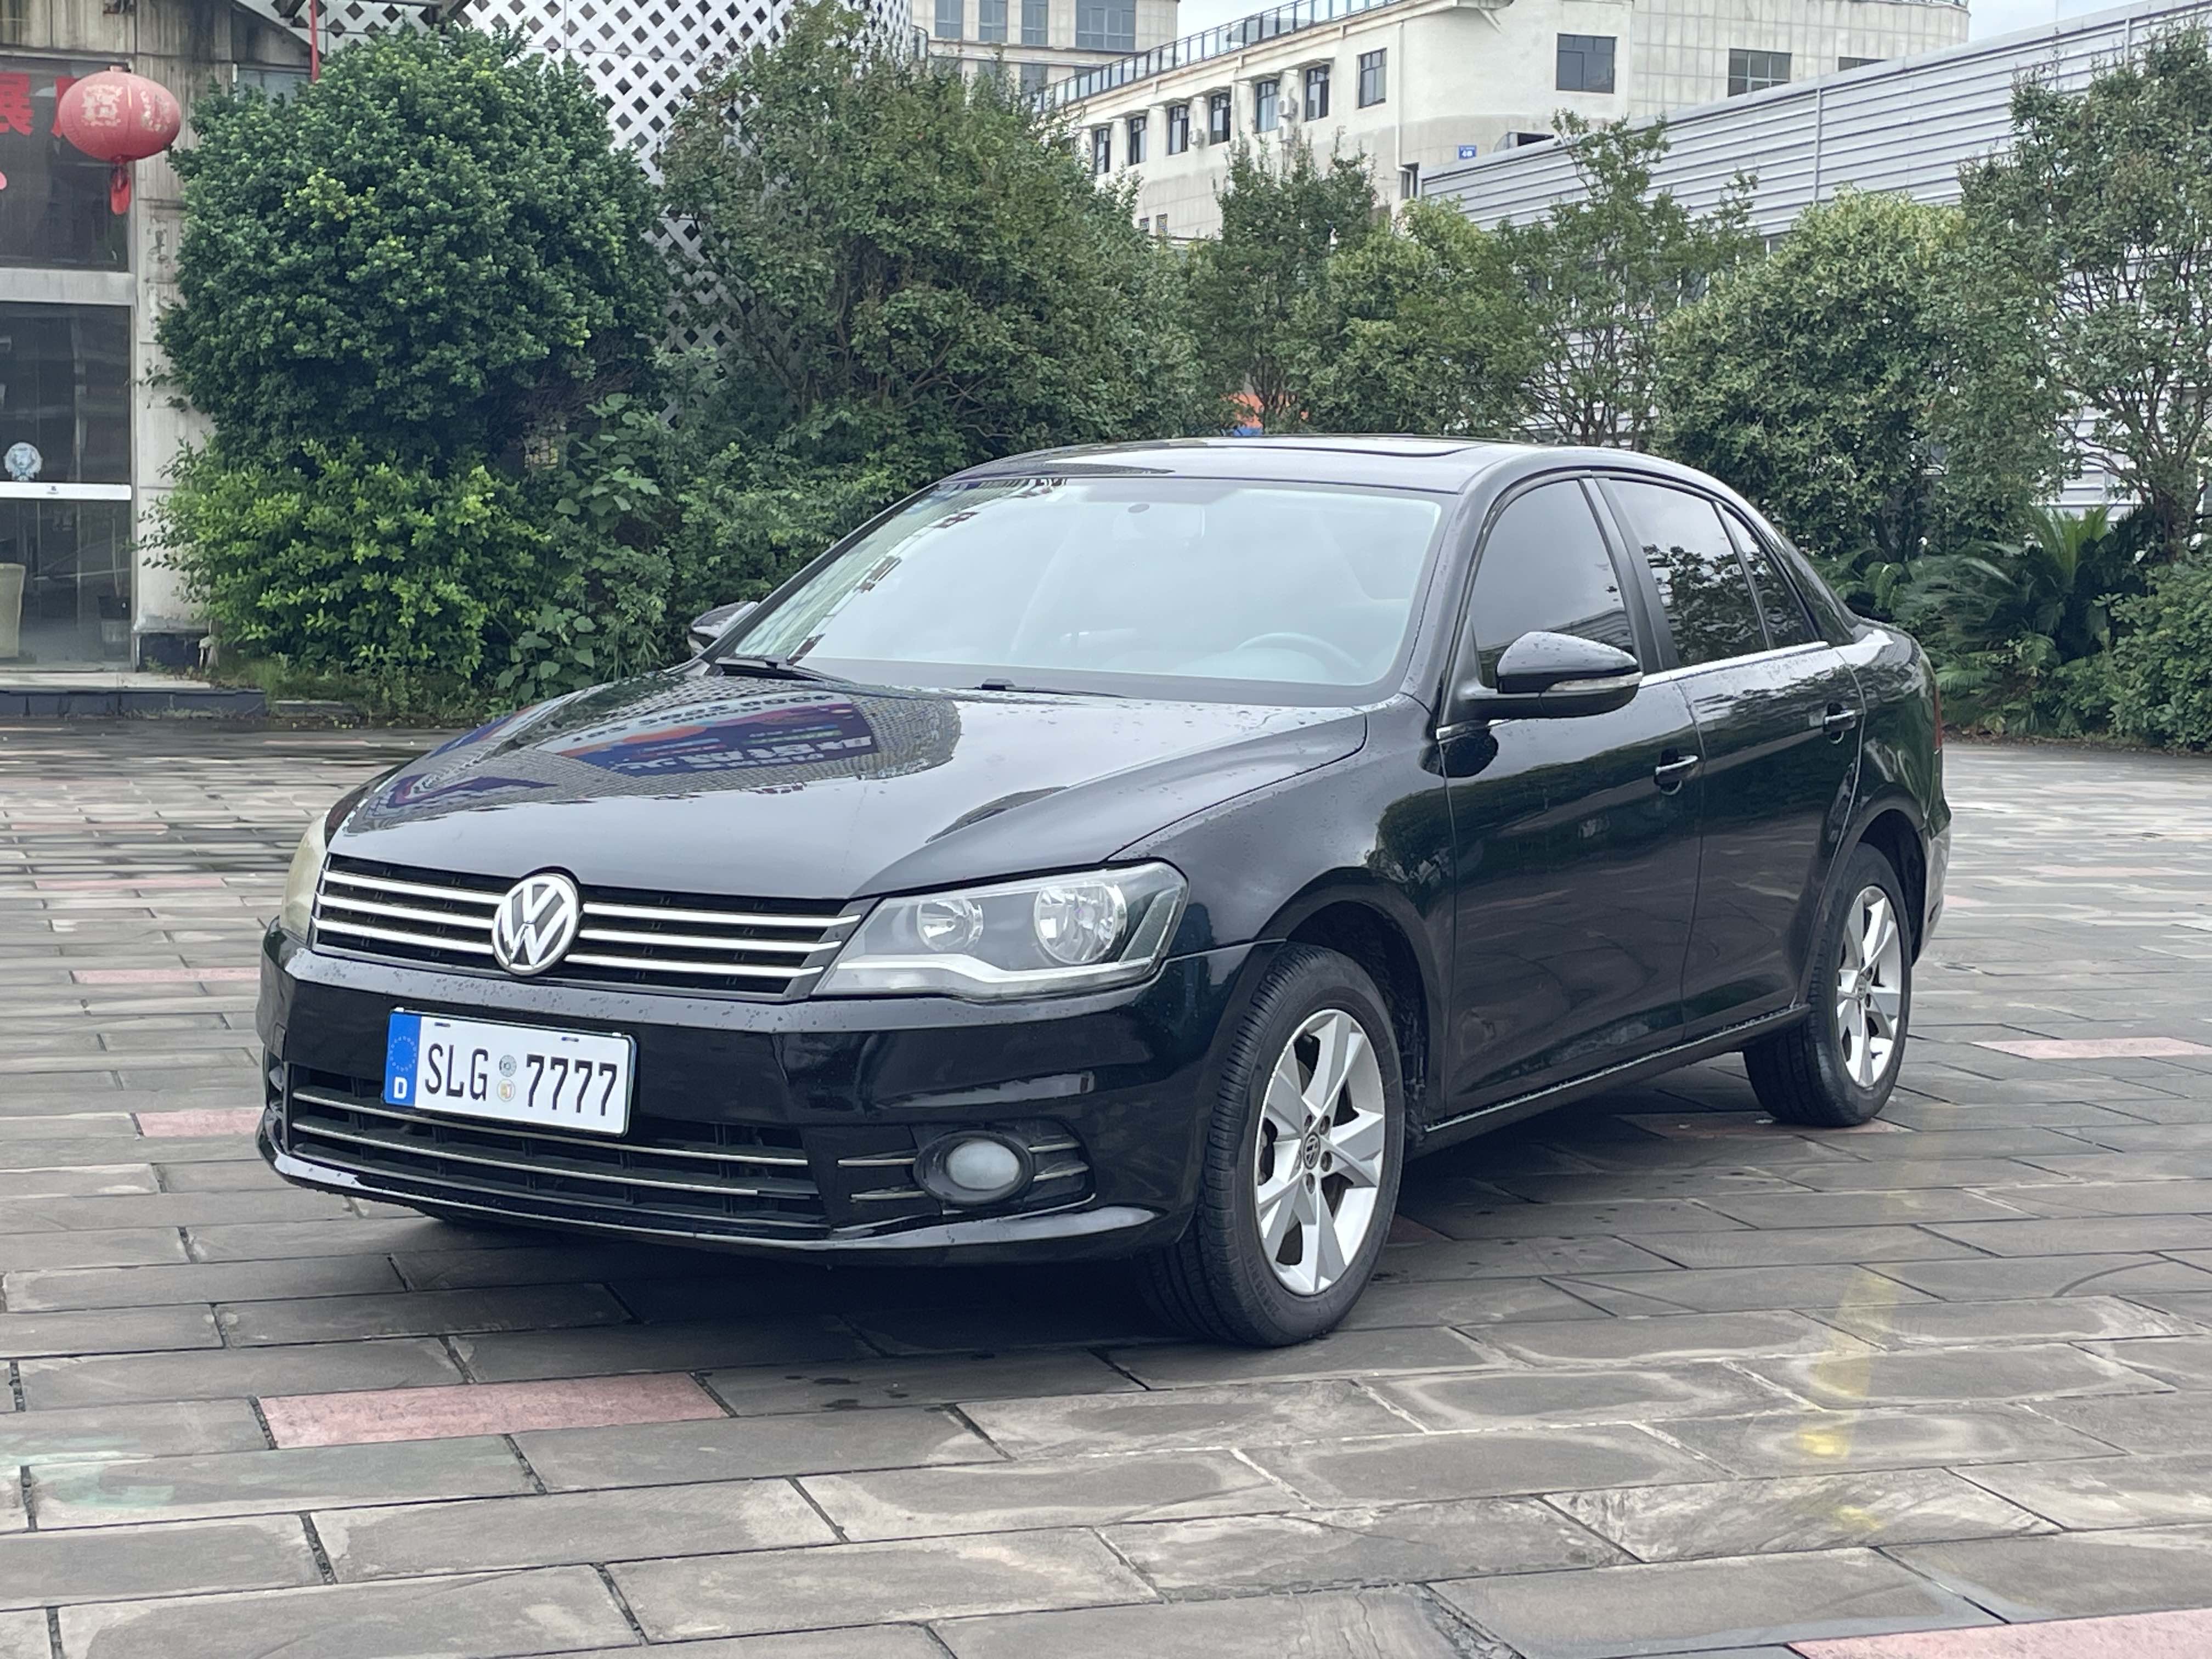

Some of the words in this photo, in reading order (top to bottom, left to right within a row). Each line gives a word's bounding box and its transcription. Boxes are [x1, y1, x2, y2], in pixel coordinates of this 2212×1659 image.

[393, 1076, 408, 1099] D
[425, 1043, 489, 1102] SLG
[526, 1053, 618, 1116] 7777
